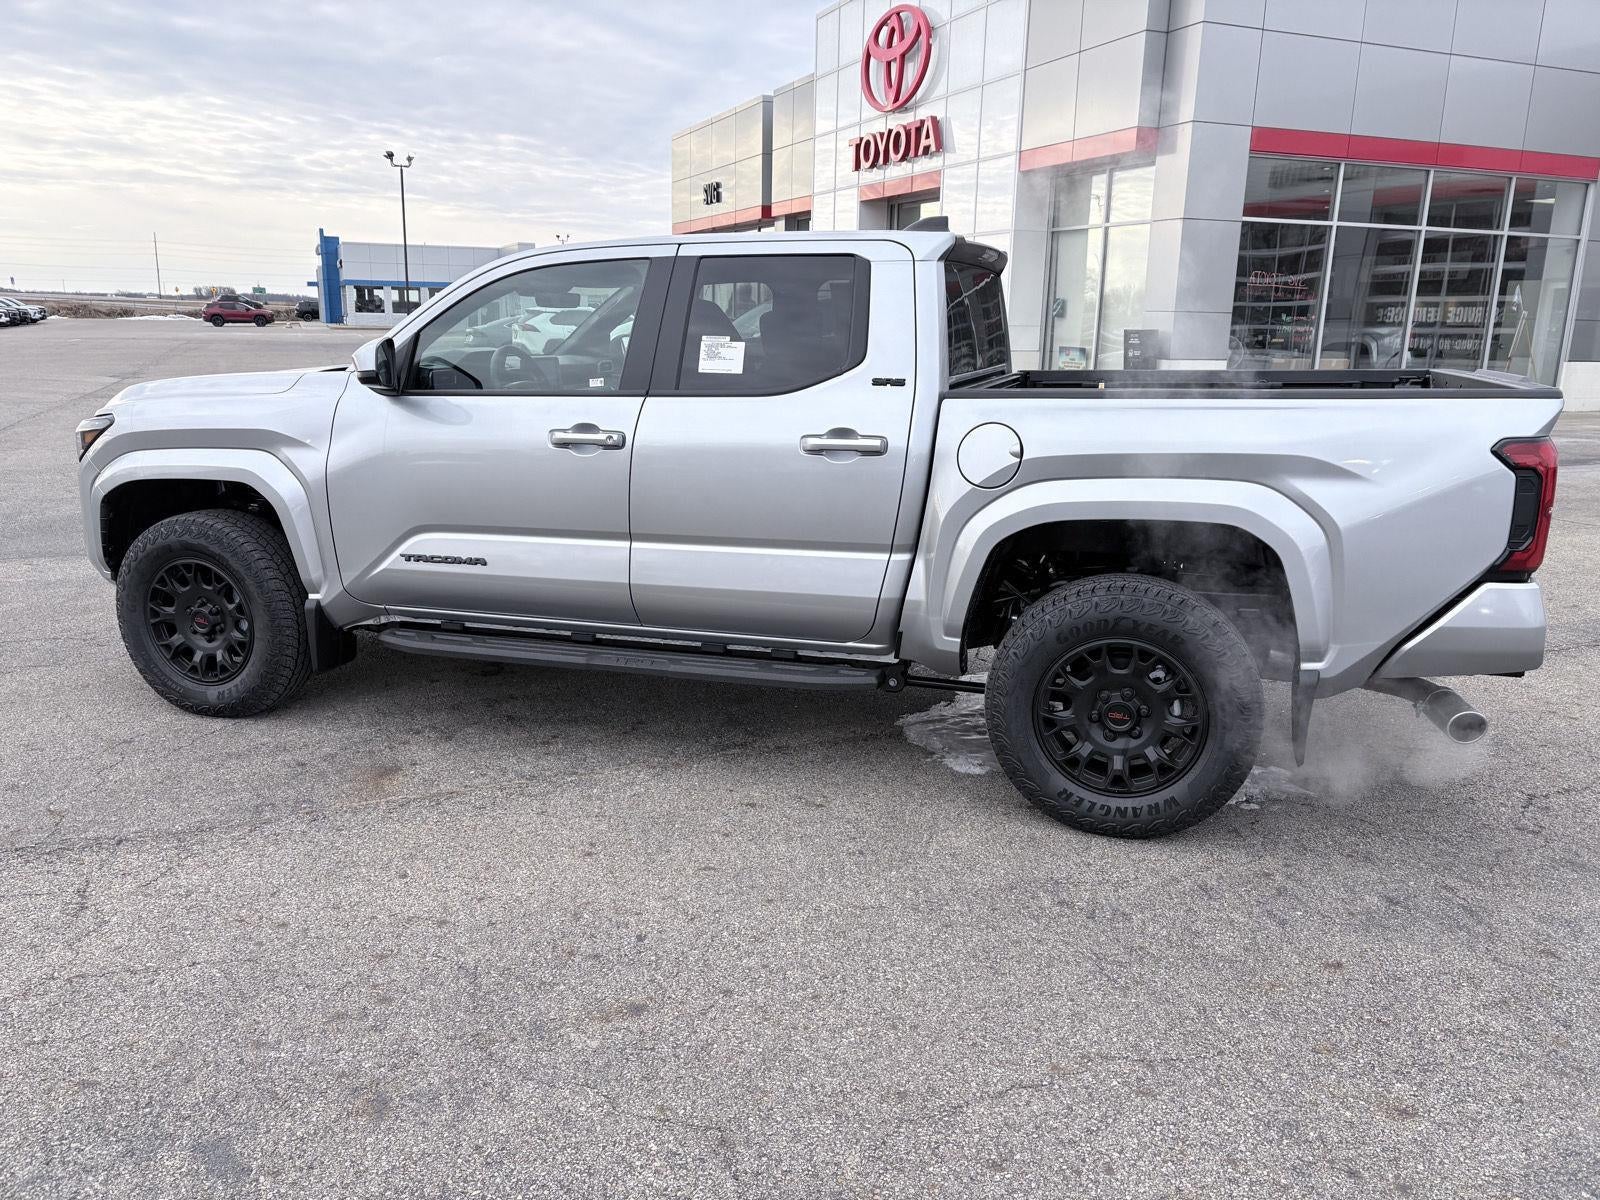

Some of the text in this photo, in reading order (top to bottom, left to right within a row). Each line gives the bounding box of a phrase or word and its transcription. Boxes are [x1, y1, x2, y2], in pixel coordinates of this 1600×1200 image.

[848, 115, 943, 172] TOYOTA
[399, 553, 487, 567] TACOMA
[1056, 787, 1182, 819] WRANGLER
